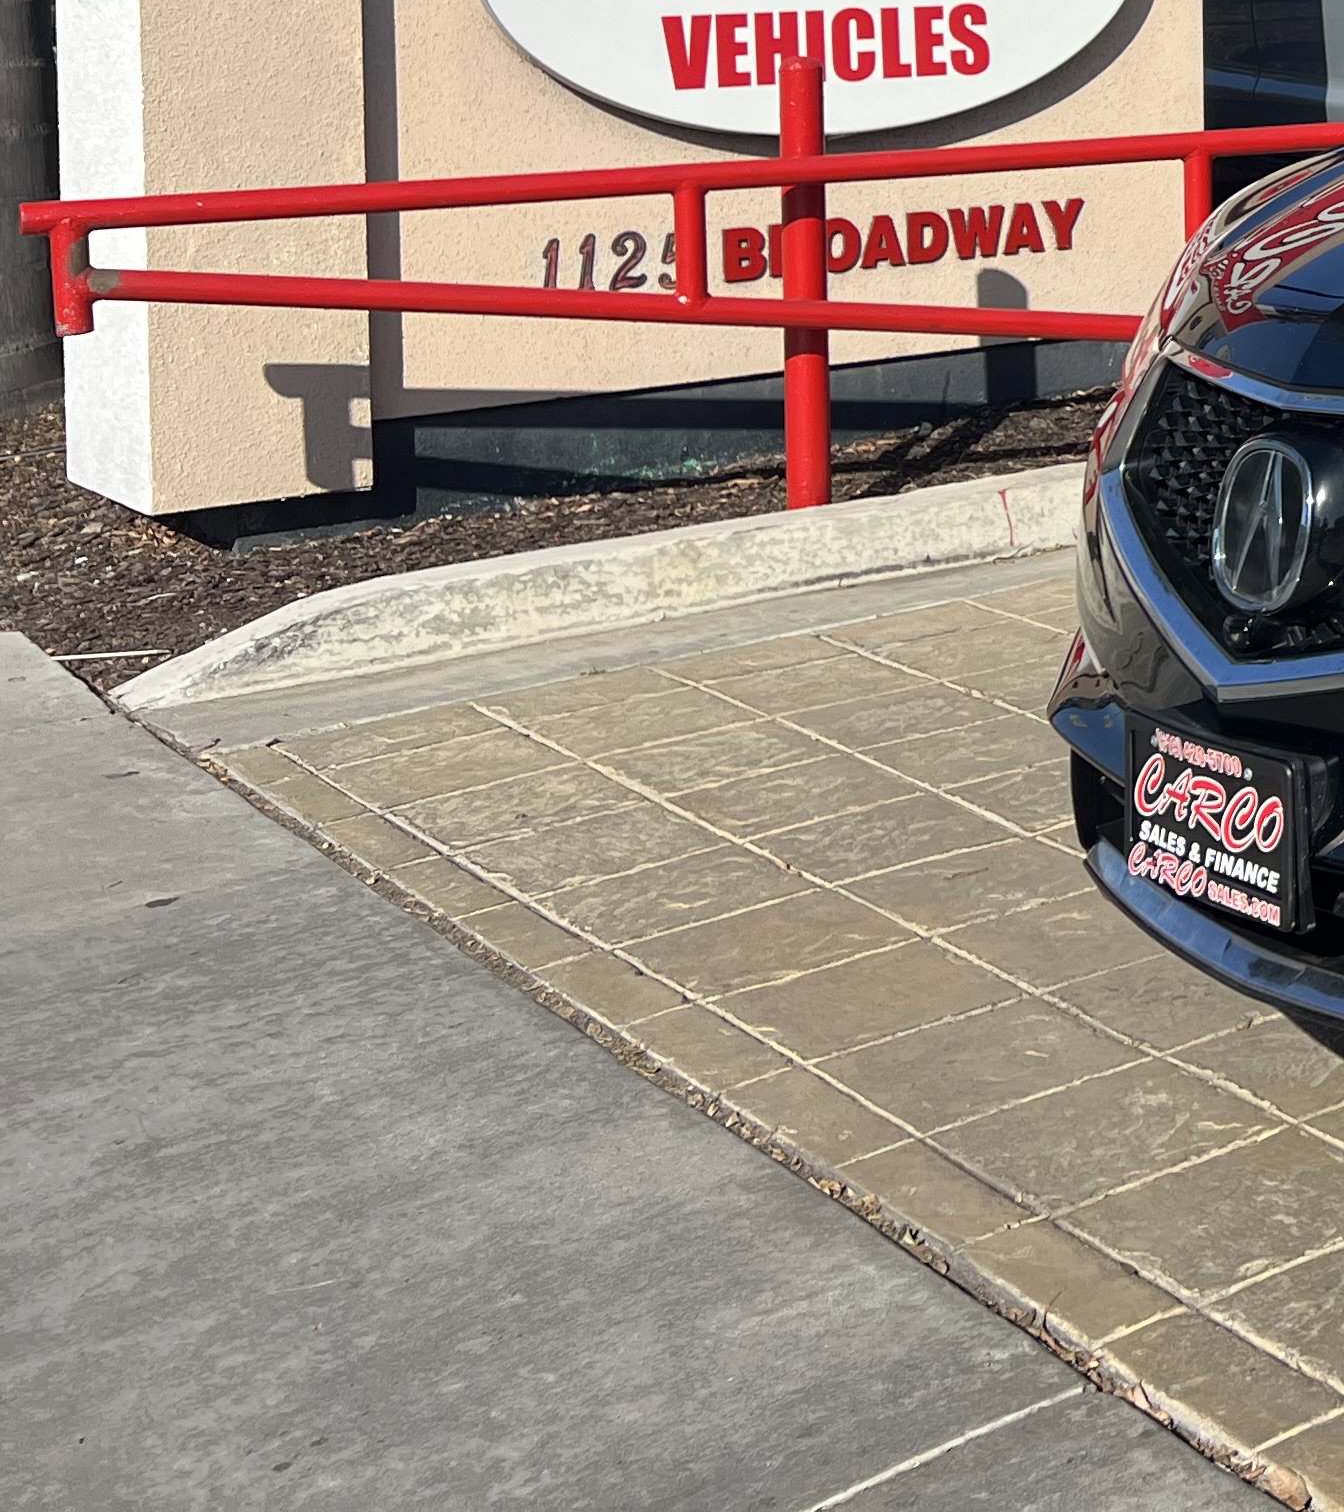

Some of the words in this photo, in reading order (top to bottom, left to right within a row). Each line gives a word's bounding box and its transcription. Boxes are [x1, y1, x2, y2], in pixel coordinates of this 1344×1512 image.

[661, 3, 991, 91] VEHICLES
[721, 196, 1085, 284] BOADWAY
[1134, 753, 1285, 854] CARCO
[1127, 840, 1208, 898] CARCO
[1138, 819, 1187, 857] SALES
[1188, 842, 1202, 864] &
[1203, 847, 1281, 895] FINANCE
